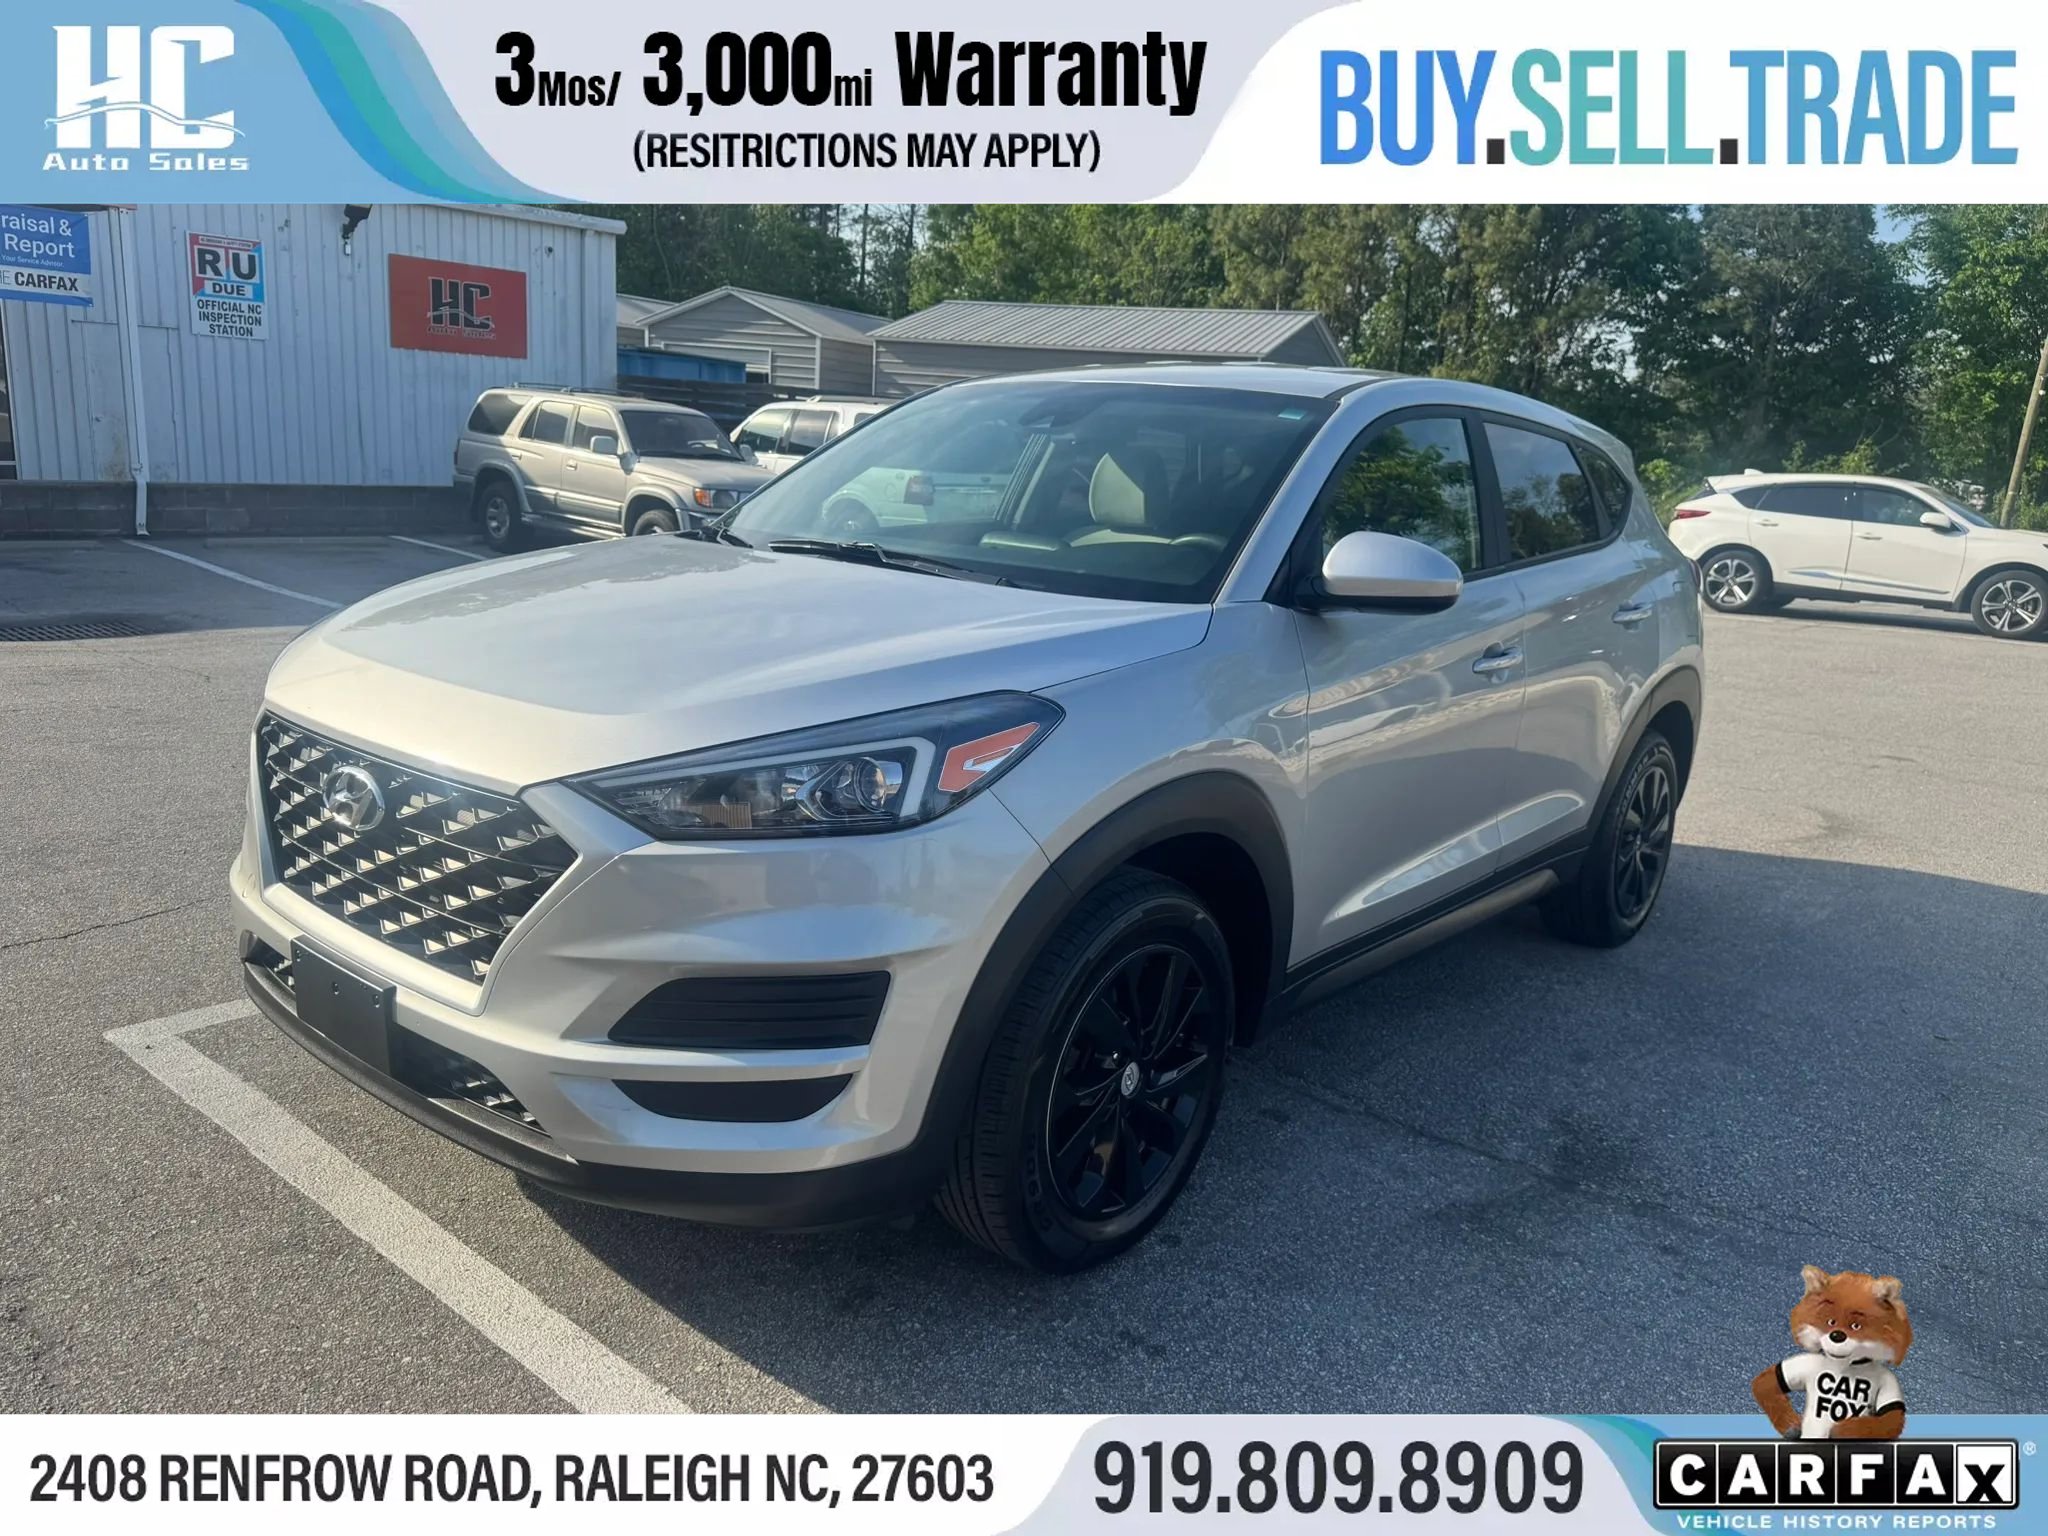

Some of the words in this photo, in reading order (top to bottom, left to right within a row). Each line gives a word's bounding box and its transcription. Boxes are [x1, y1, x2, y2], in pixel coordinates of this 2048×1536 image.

[59, 219, 73, 237] &
[4, 233, 76, 258] Report
[17, 256, 40, 266] Service
[14, 271, 79, 292] CARFAX
[212, 282, 246, 296] DUE
[197, 299, 245, 313] OFFICIAL
[247, 304, 262, 315] NC
[428, 277, 492, 331] HC
[198, 310, 262, 326] INSPECTION
[209, 323, 253, 337] STATION
